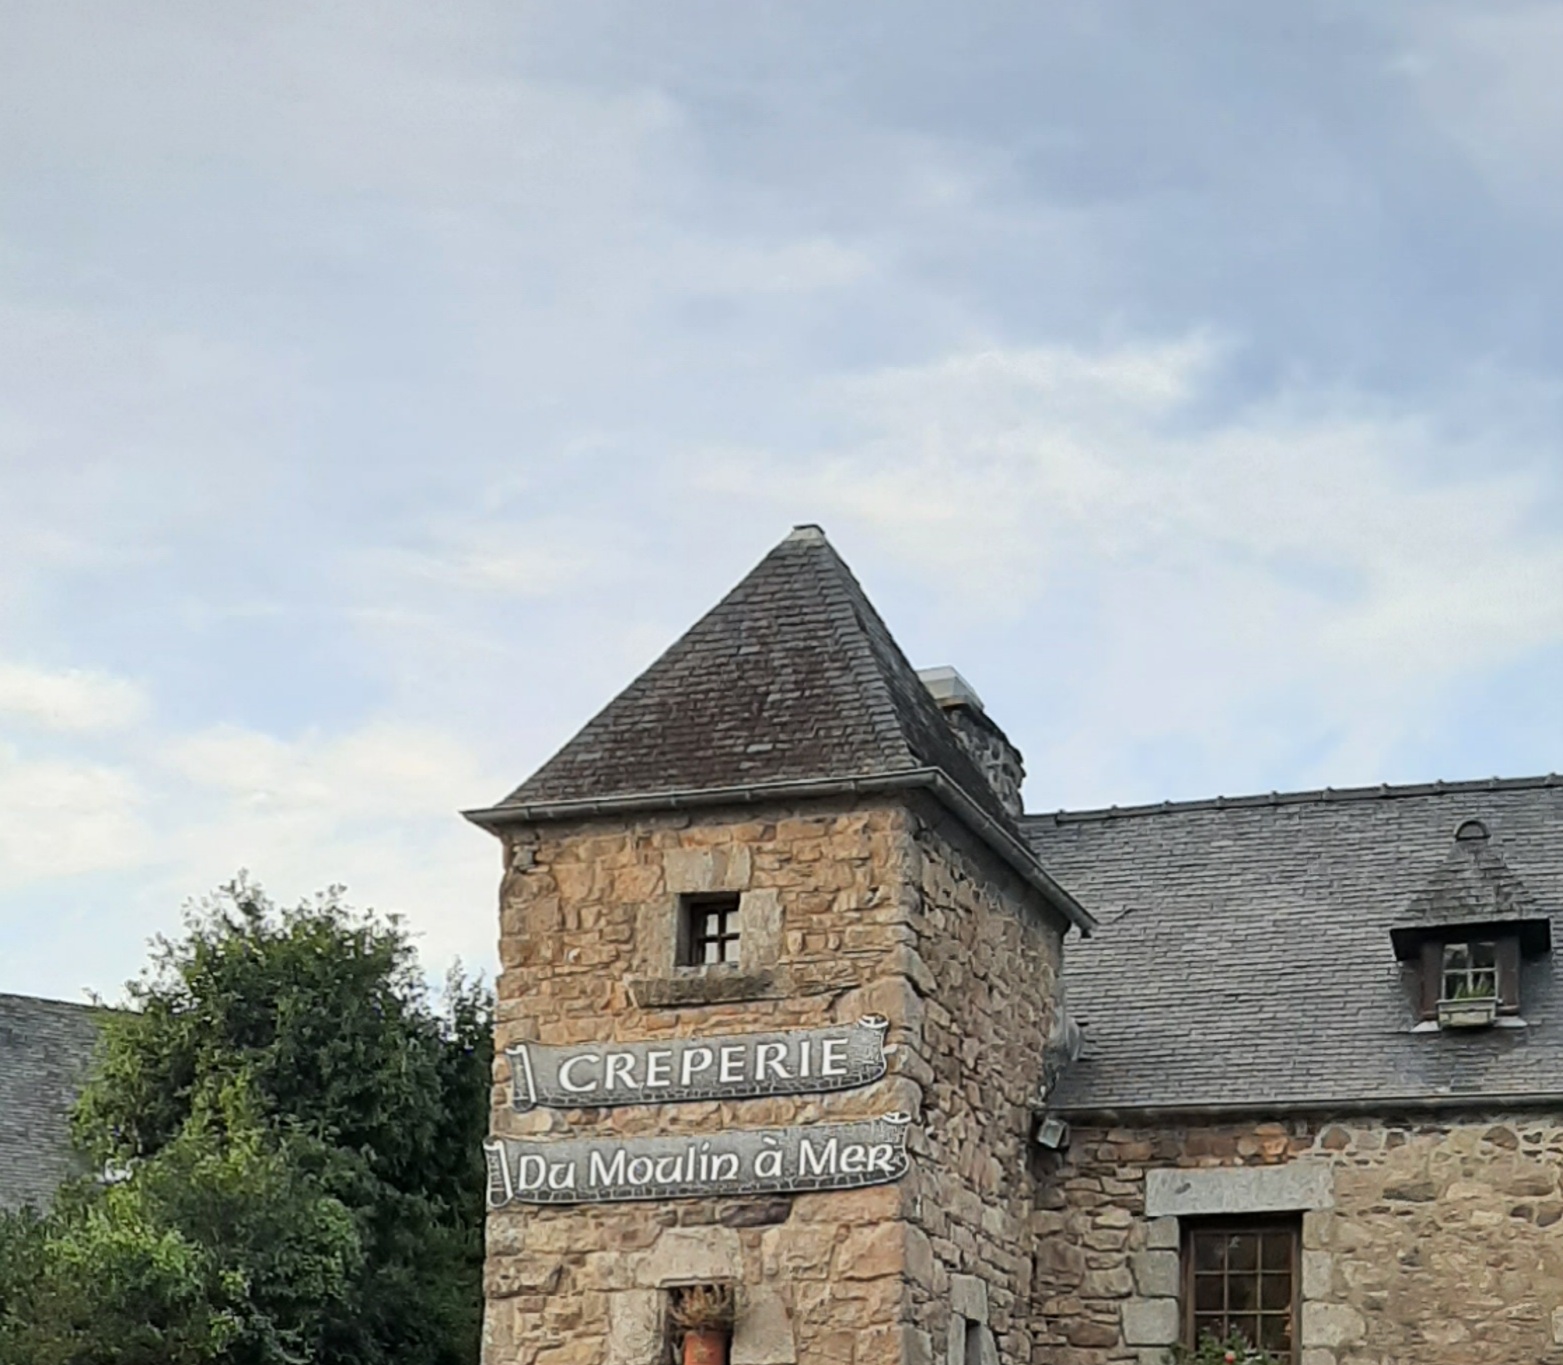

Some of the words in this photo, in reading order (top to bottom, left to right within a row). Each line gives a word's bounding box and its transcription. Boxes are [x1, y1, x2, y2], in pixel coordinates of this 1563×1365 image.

[558, 1037, 850, 1092] CREPERIE
[518, 1154, 576, 1191] Du
[589, 1141, 739, 1189] Moulin
[754, 1136, 783, 1178] à
